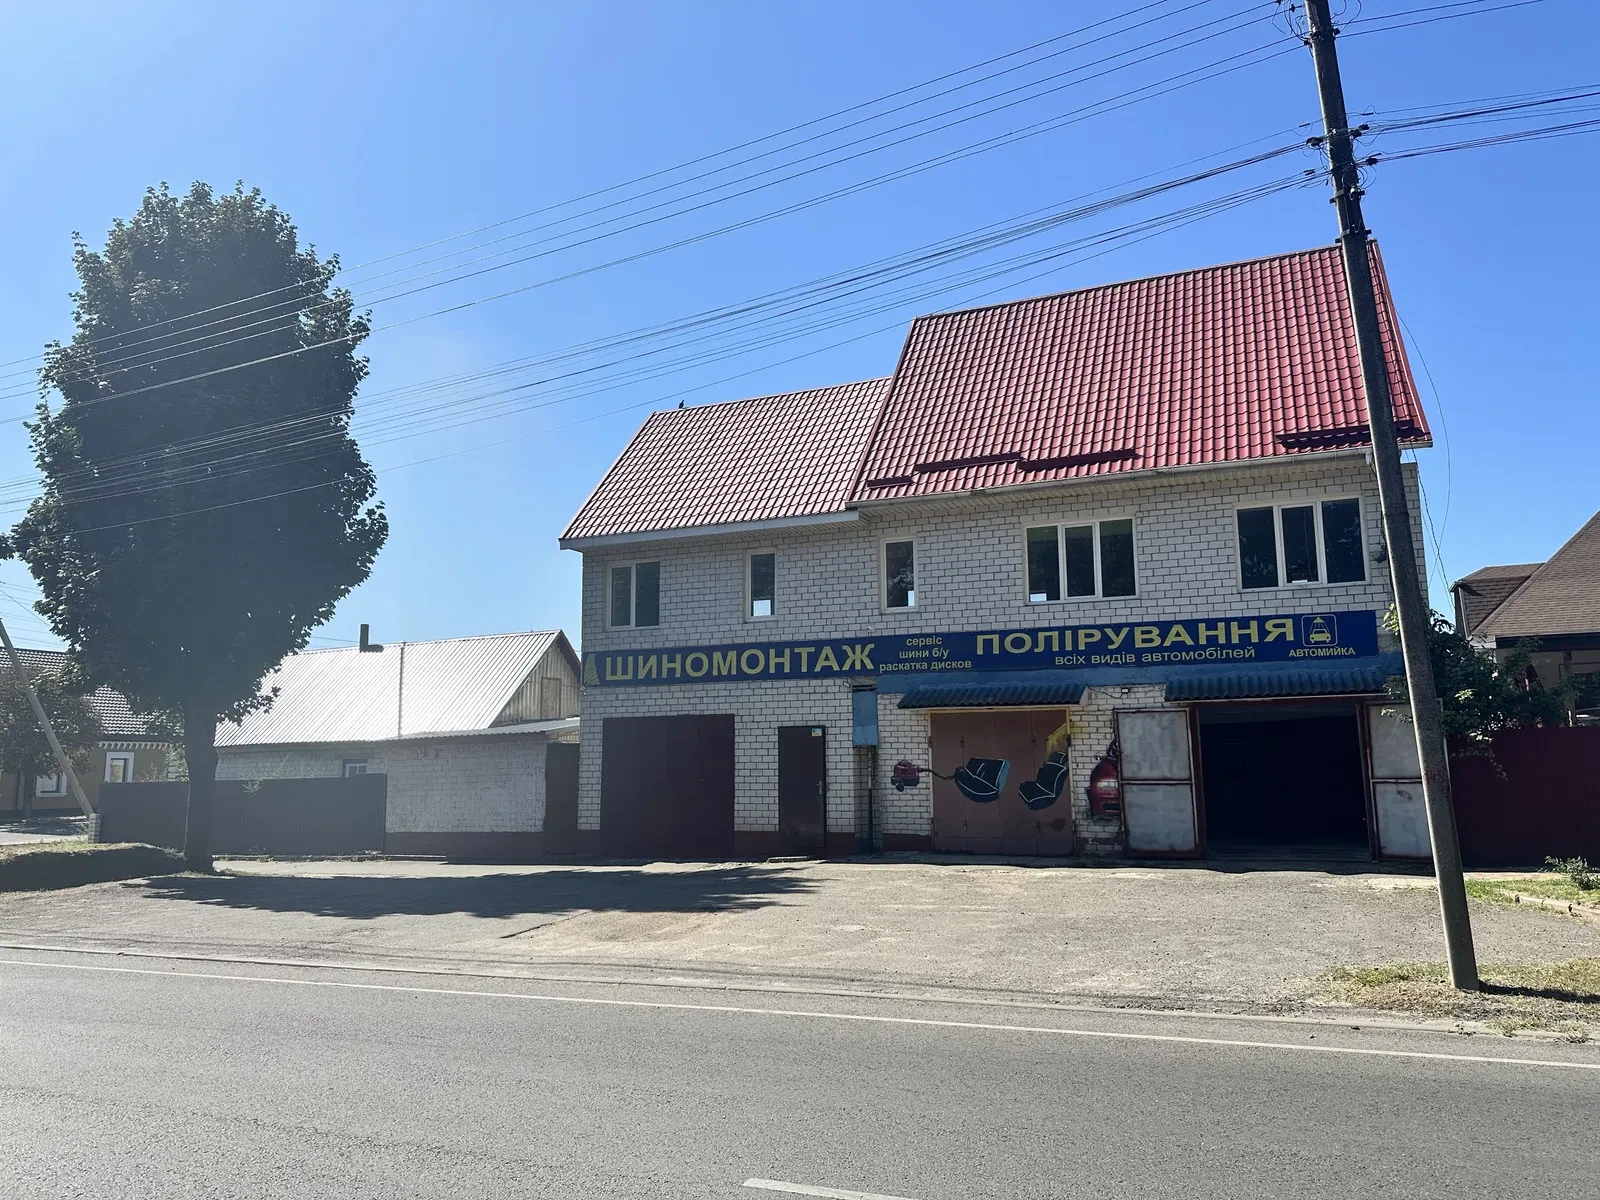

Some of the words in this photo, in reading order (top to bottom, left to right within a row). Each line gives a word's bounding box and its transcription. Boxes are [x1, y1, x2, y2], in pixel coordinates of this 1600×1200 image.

[906, 635, 943, 647] сервіс
[976, 618, 1294, 655] ПОЛІРУВАННЯ
[899, 648, 929, 659] шини
[932, 647, 949, 660] б/у
[1055, 652, 1086, 666] всіх
[1092, 650, 1136, 665] видів
[1141, 646, 1255, 663] автомобілей
[1288, 645, 1356, 658] АВТОМИЙКА
[605, 643, 875, 680] ШИНОМОНТАЖ
[879, 663, 928, 673] раскатка
[930, 660, 972, 671] дисков
